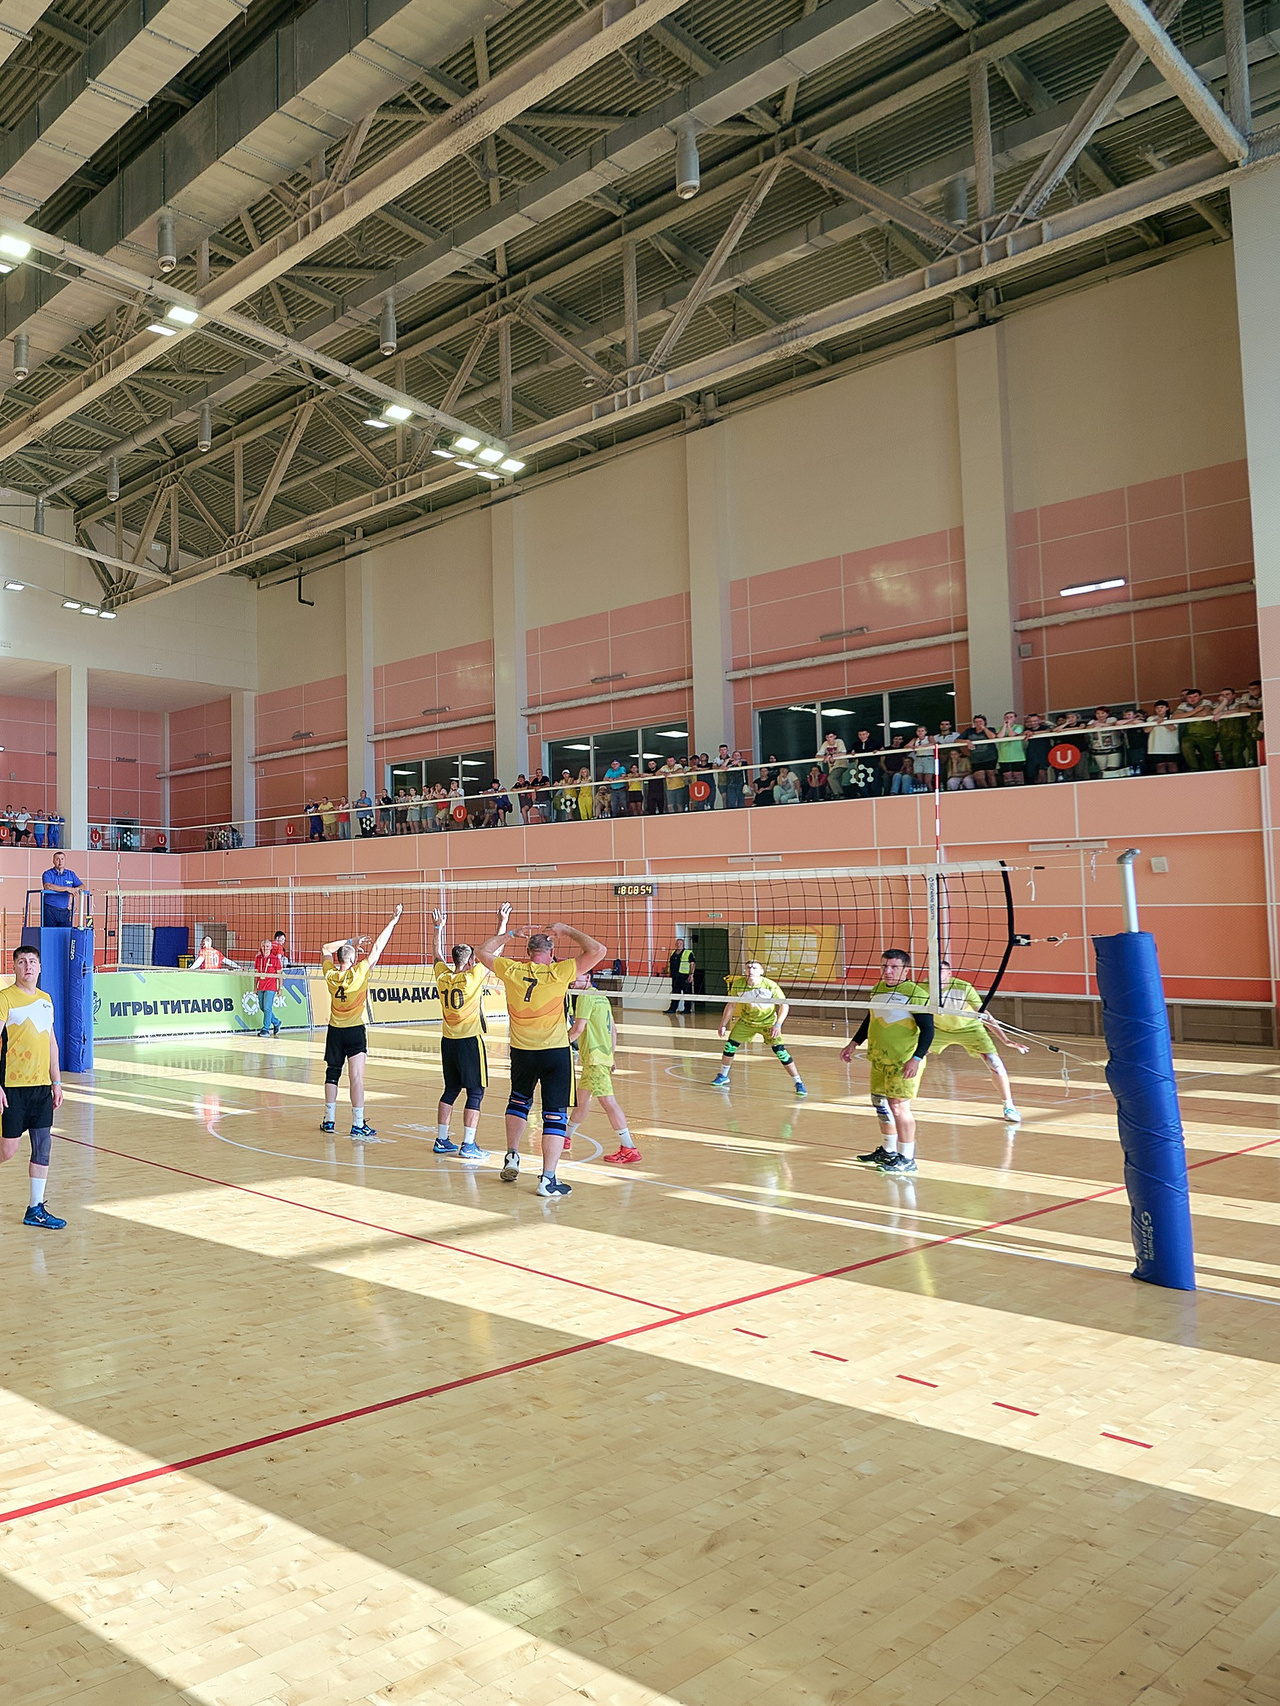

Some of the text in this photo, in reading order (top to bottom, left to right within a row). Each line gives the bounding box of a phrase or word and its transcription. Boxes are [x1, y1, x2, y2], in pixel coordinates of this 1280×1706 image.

[334, 985, 347, 1002] 4
[440, 988, 465, 1010] 10
[523, 976, 538, 1003] 7
[109, 998, 234, 1017] ИГРЫ ТИТАНОВ
